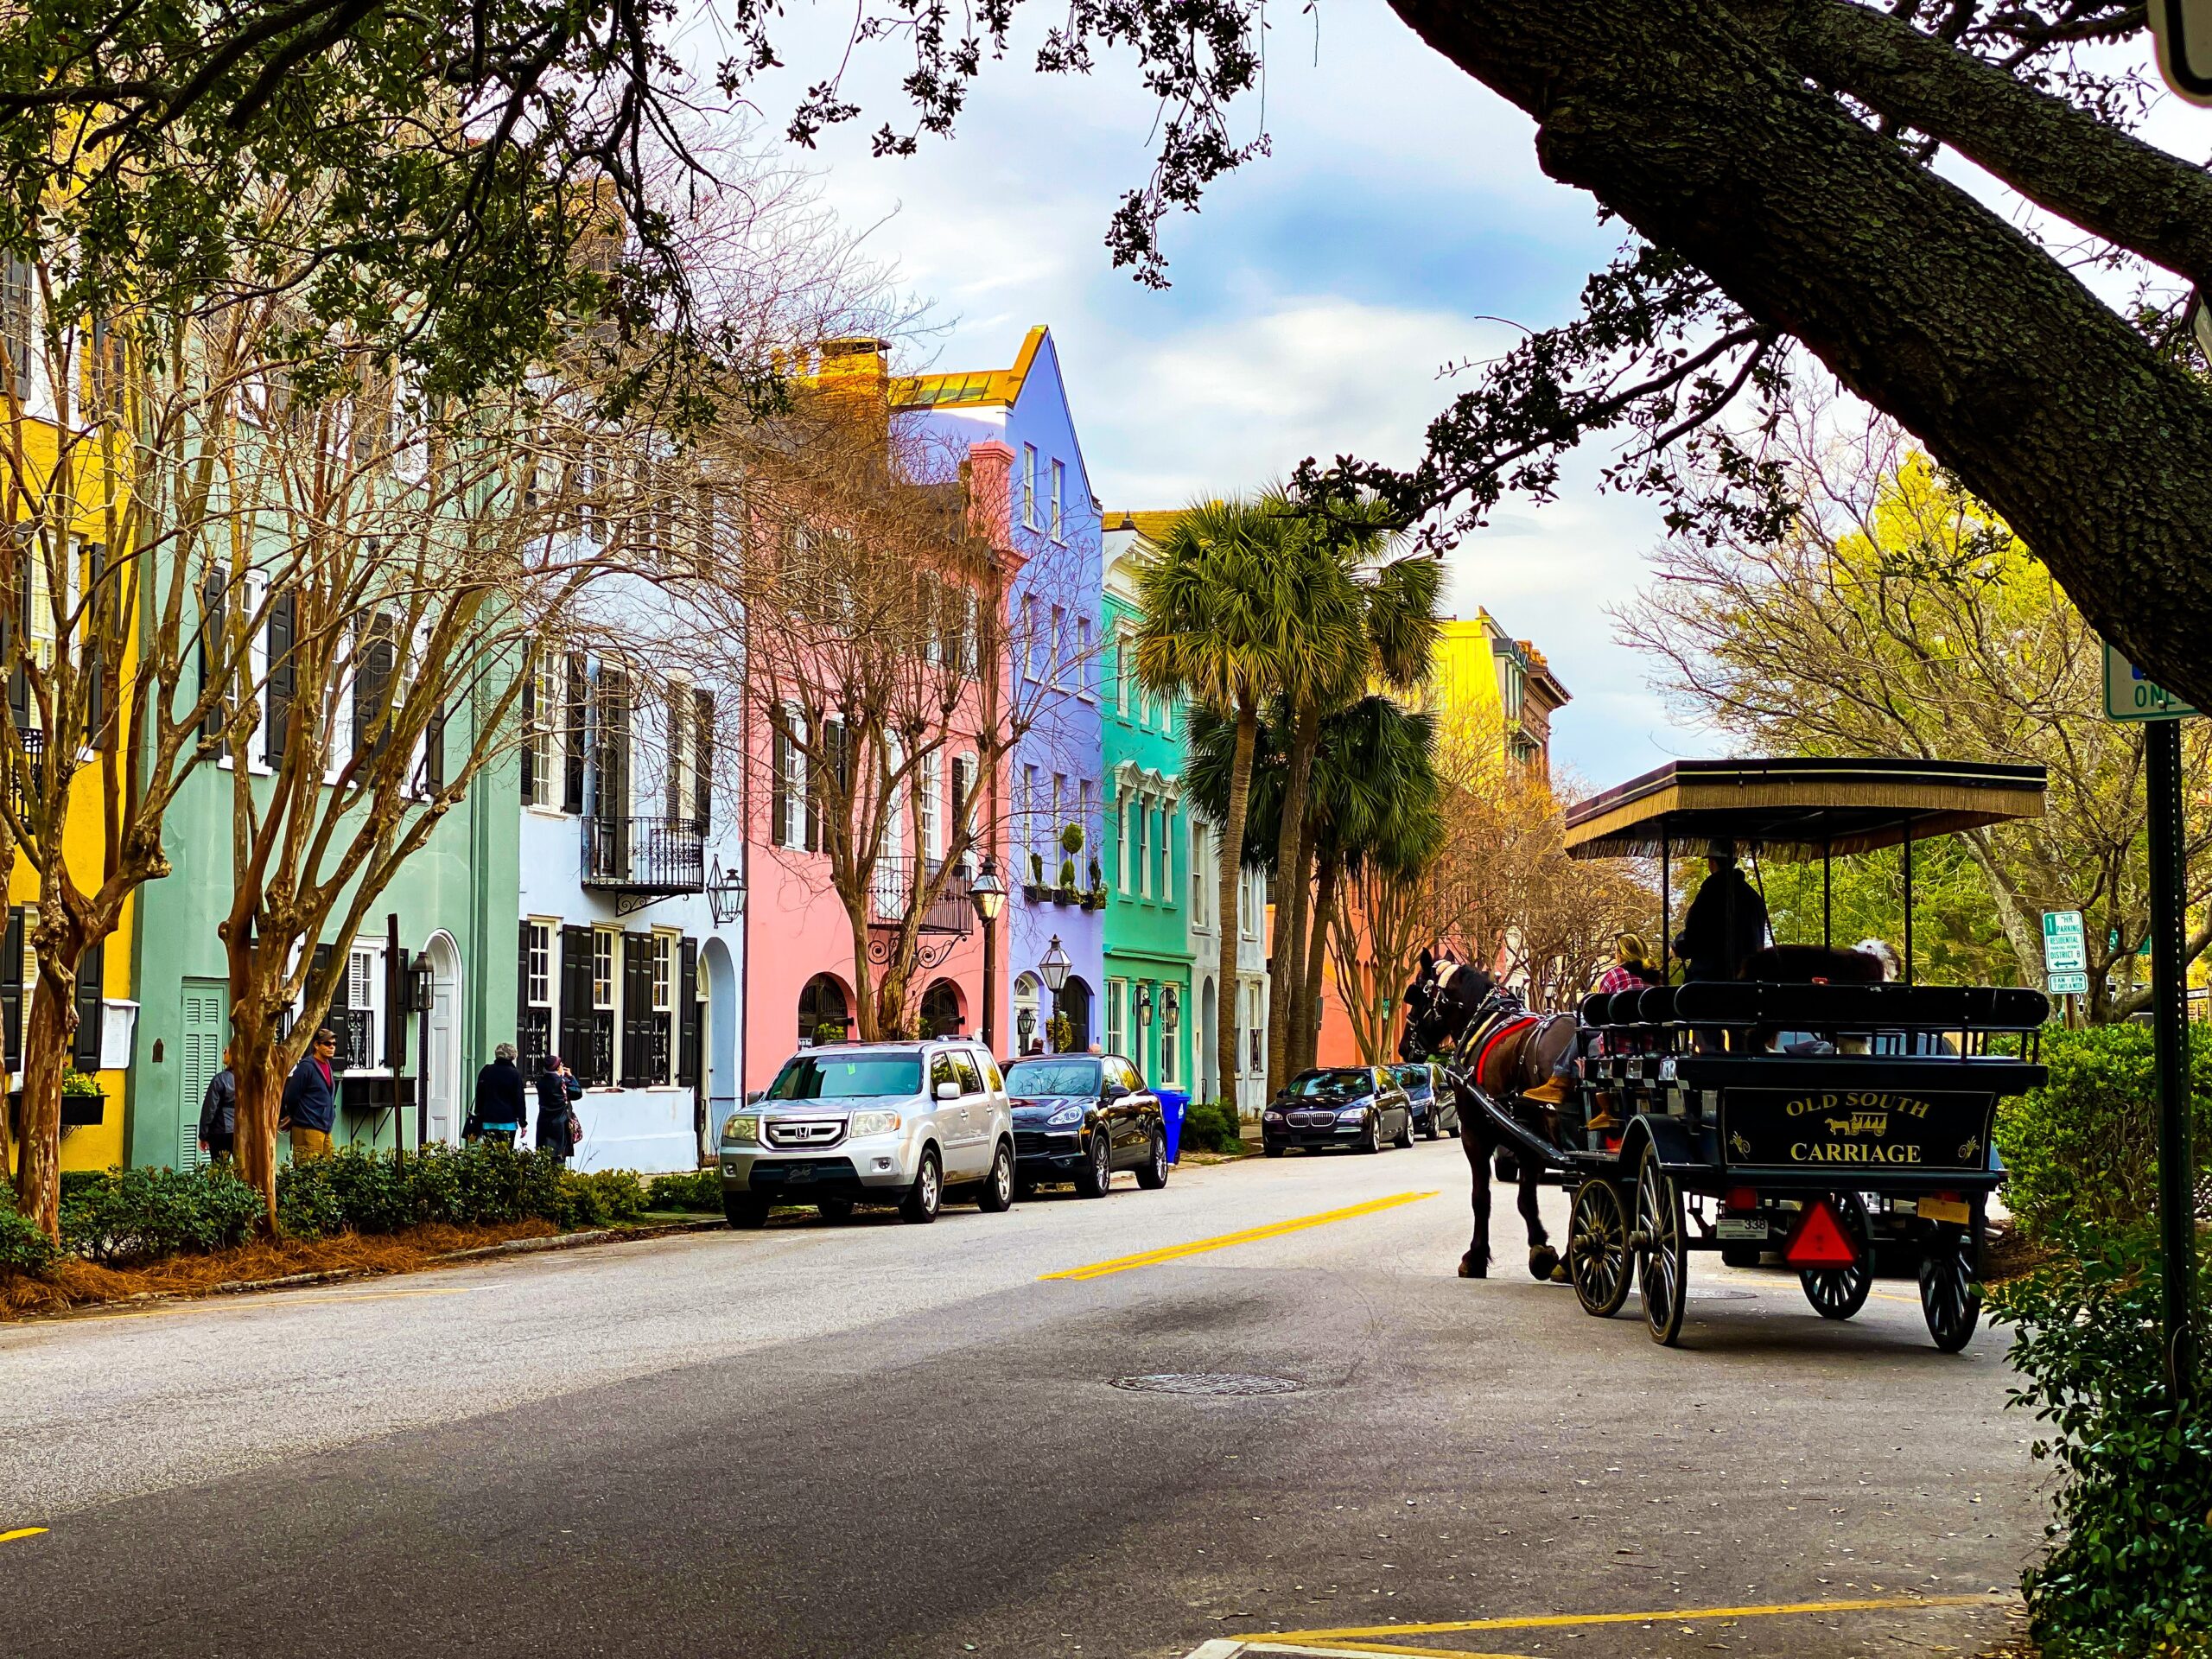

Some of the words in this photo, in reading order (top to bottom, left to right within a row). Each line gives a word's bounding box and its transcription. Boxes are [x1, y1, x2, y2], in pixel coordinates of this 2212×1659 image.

[2135, 685, 2185, 708] ONL
[2048, 918, 2053, 932] 1
[2050, 936, 2079, 944] RESIDENTIAL
[1786, 1094, 1838, 1116] OLD
[1846, 1092, 1930, 1119] SOUTH
[1790, 1142, 1922, 1163] CARRIAGE
[1745, 1217, 1765, 1230] 338
